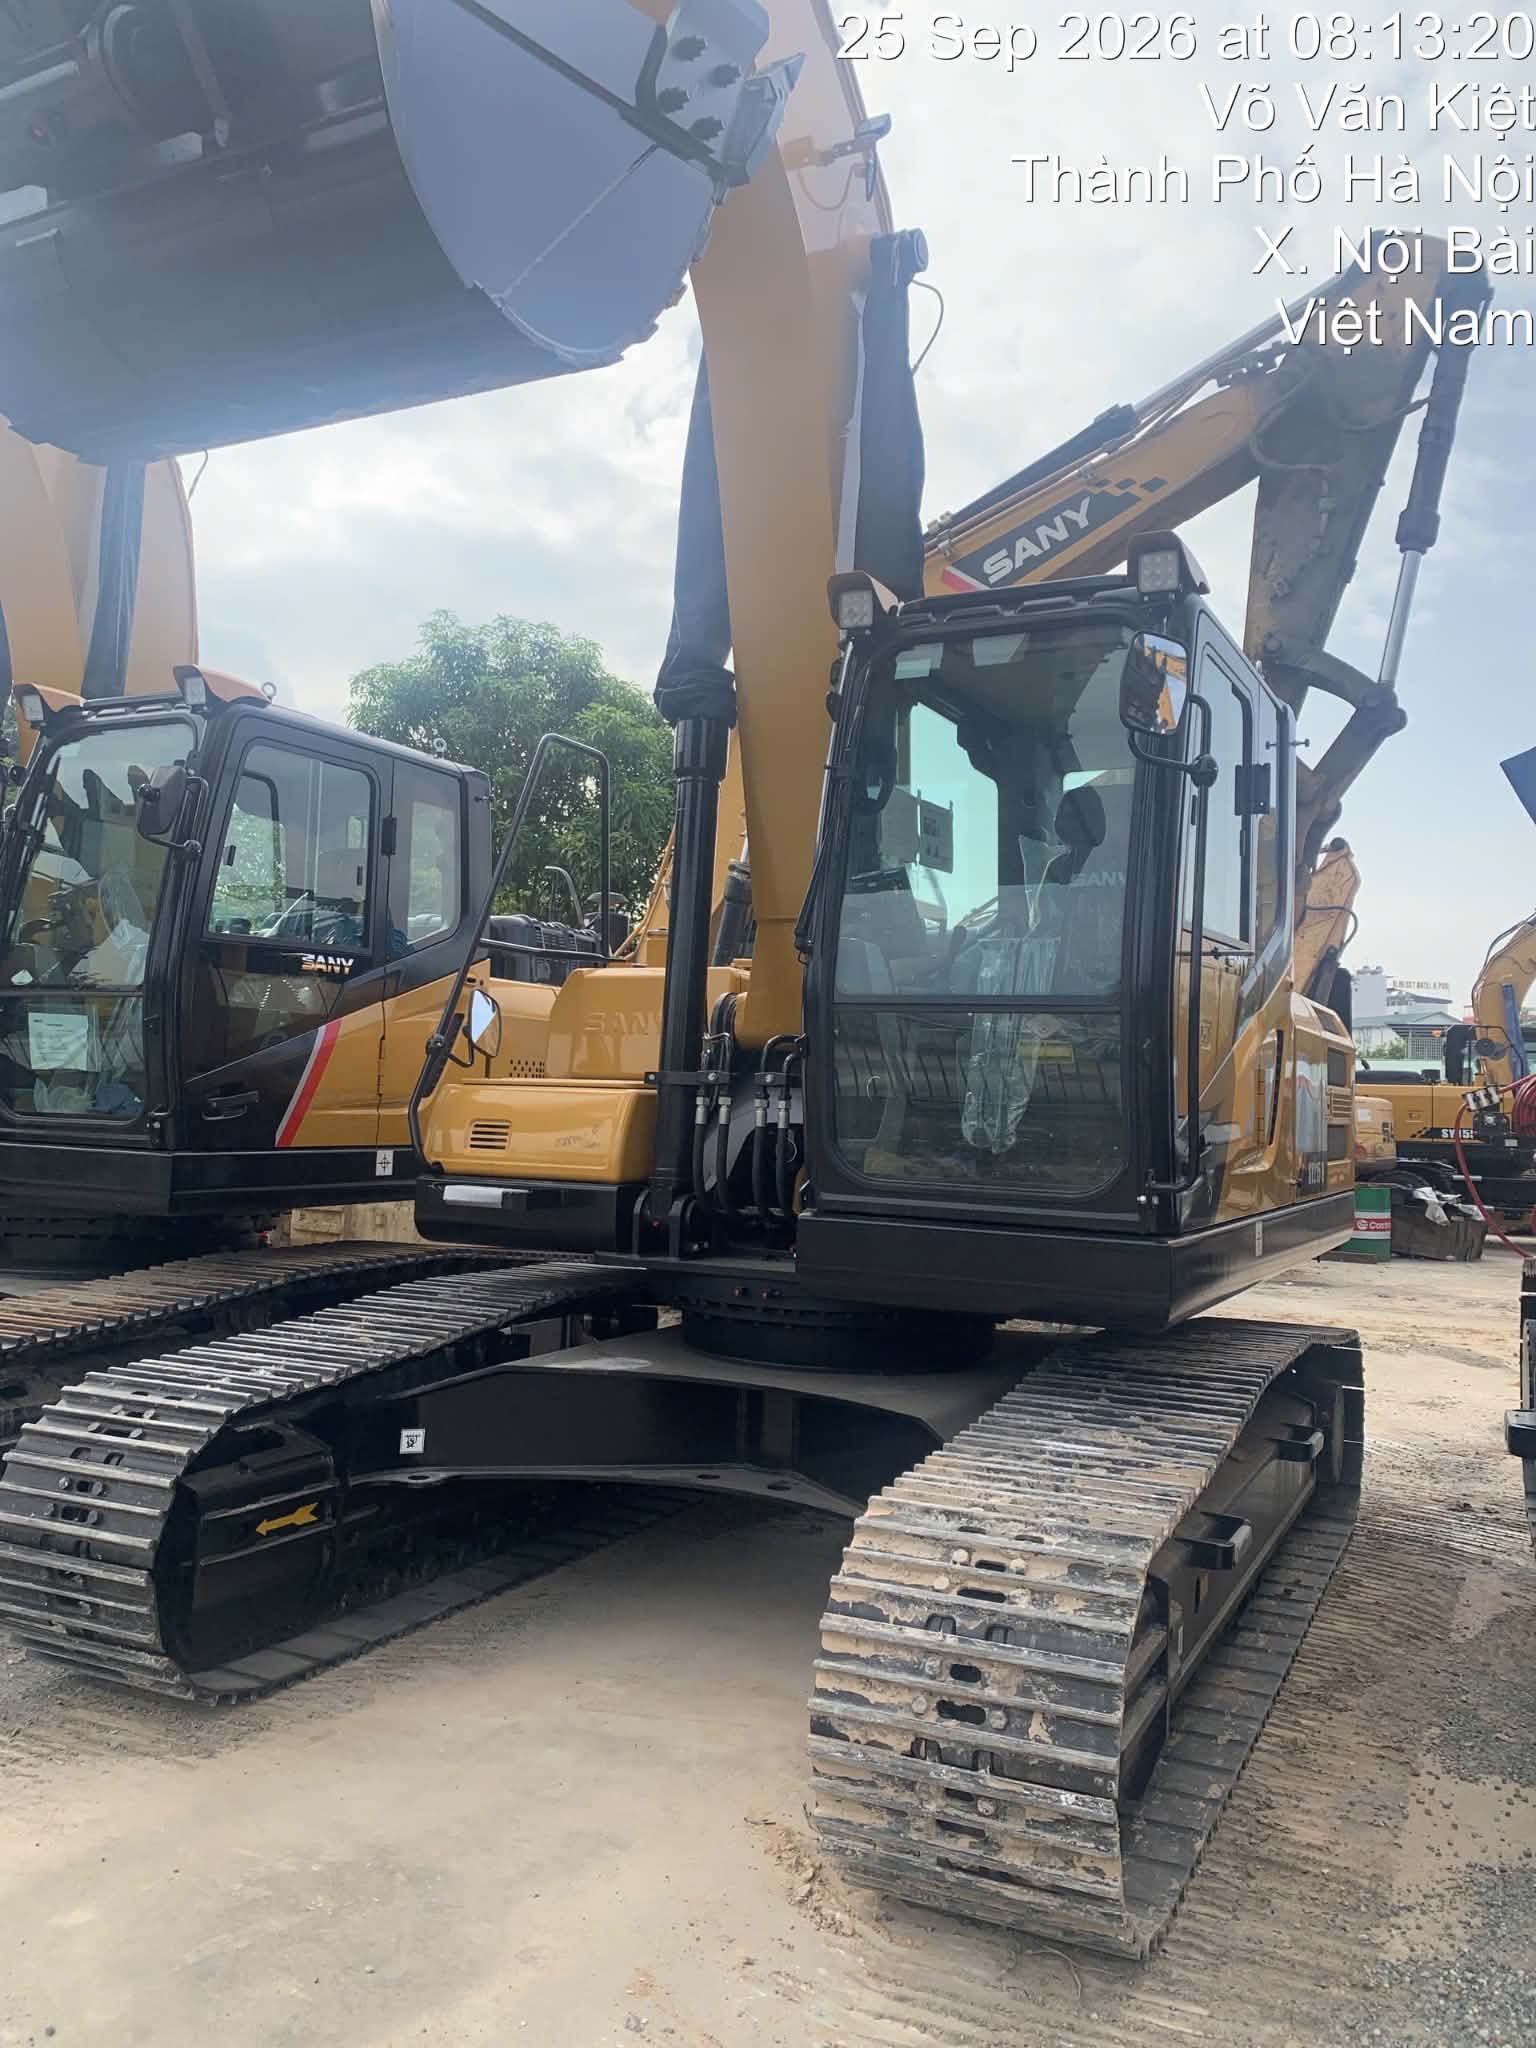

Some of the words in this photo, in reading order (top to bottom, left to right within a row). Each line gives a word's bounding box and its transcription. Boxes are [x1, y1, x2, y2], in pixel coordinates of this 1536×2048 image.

[982, 496, 1092, 584] SANY
[301, 953, 355, 975] SANY
[583, 1009, 661, 1036] SAN
